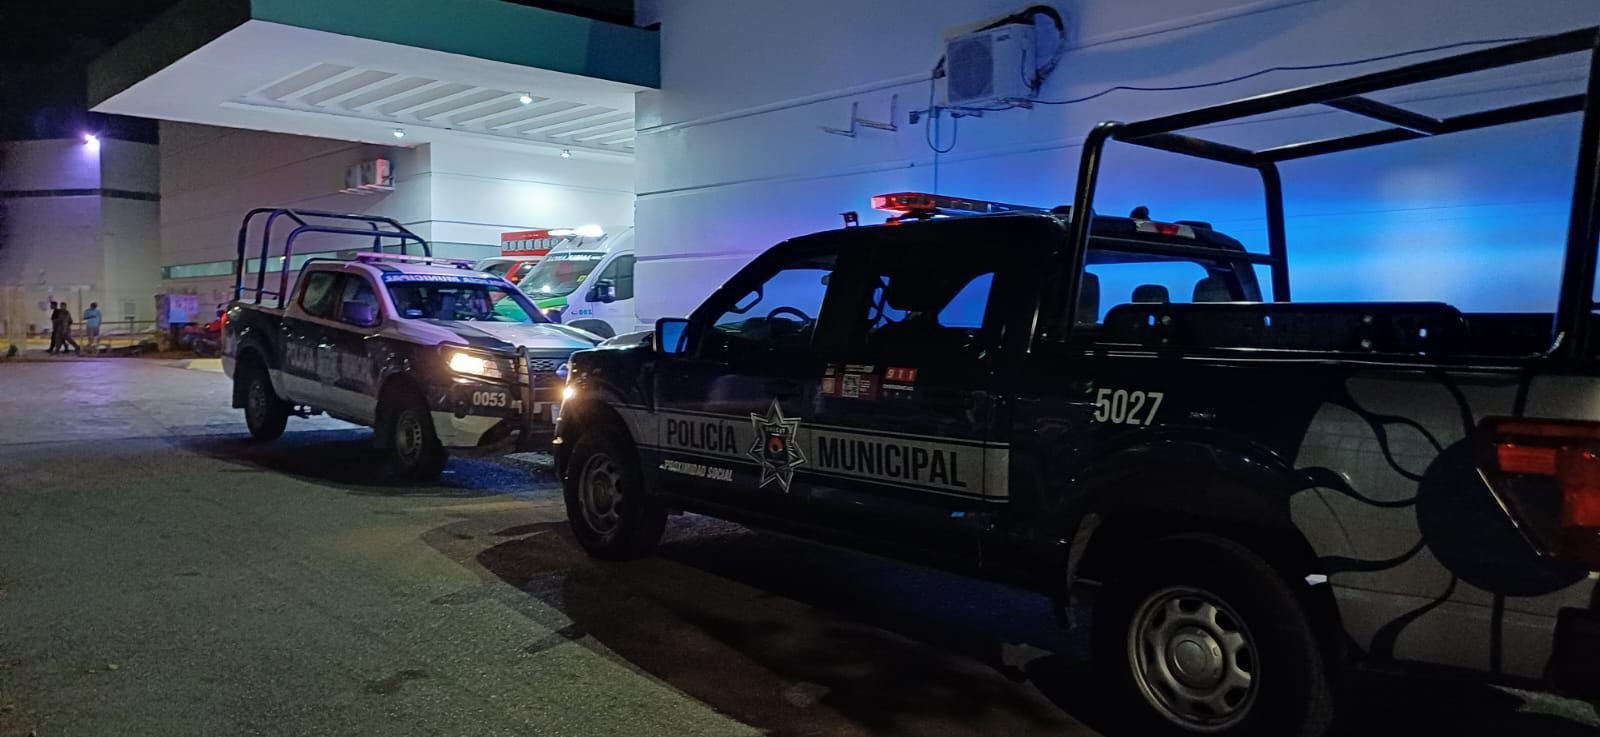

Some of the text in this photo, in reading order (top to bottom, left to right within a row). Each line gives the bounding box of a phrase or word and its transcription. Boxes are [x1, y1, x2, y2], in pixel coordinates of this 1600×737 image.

[886, 368, 915, 380] 911
[472, 391, 506, 407] 0053
[1095, 388, 1165, 426] 5027
[667, 418, 967, 488] POLICÍA MUNICIPAL
